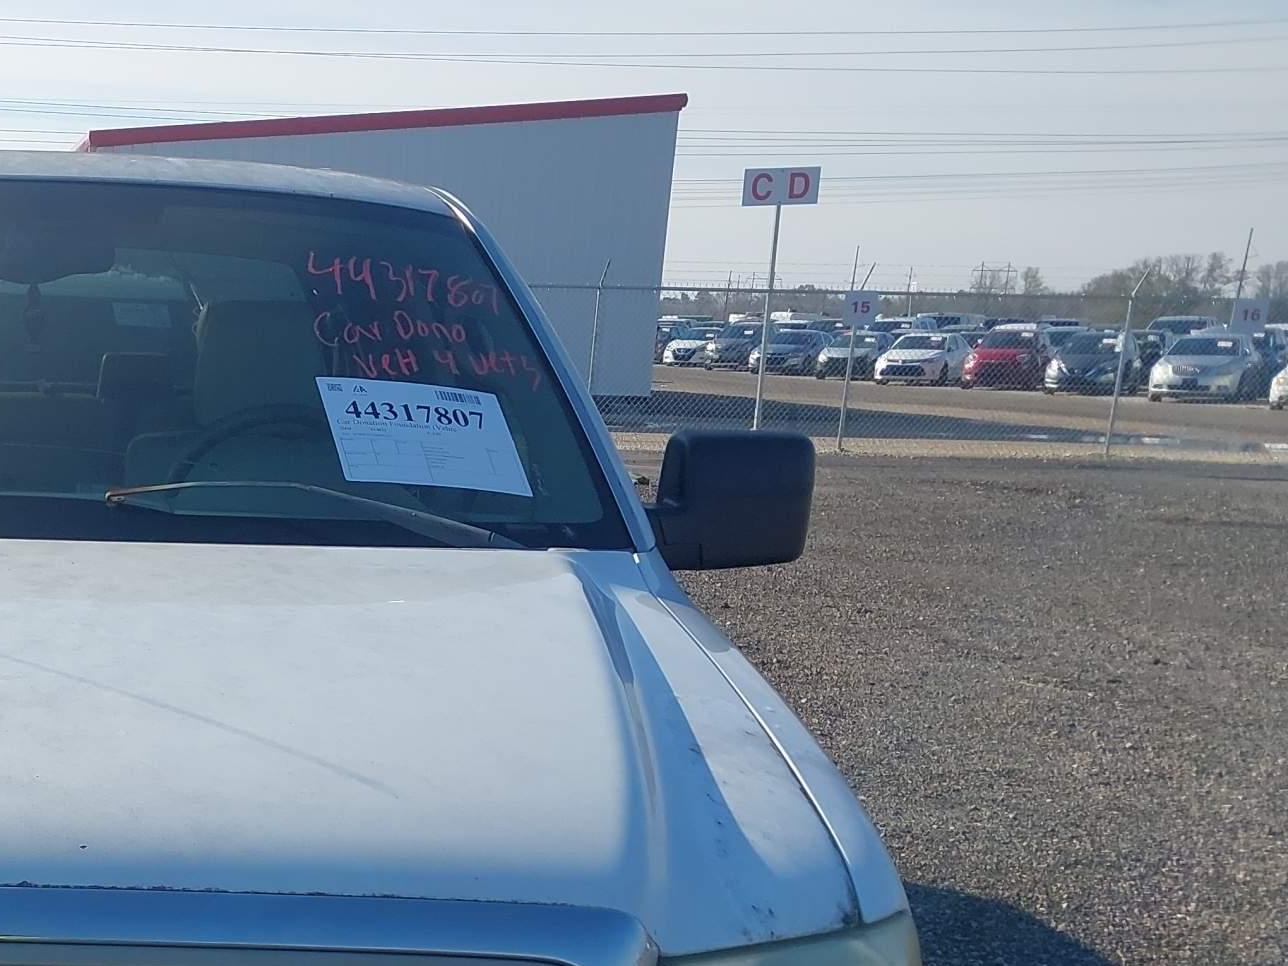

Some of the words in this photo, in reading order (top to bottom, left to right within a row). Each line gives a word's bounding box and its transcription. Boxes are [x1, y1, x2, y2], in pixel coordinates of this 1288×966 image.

[752, 173, 773, 200] C
[789, 172, 809, 199] D
[307, 251, 500, 315] 44317807
[852, 301, 870, 313] 15
[1243, 309, 1261, 320] 16
[314, 312, 382, 346] Car
[345, 400, 483, 430] 44317807
